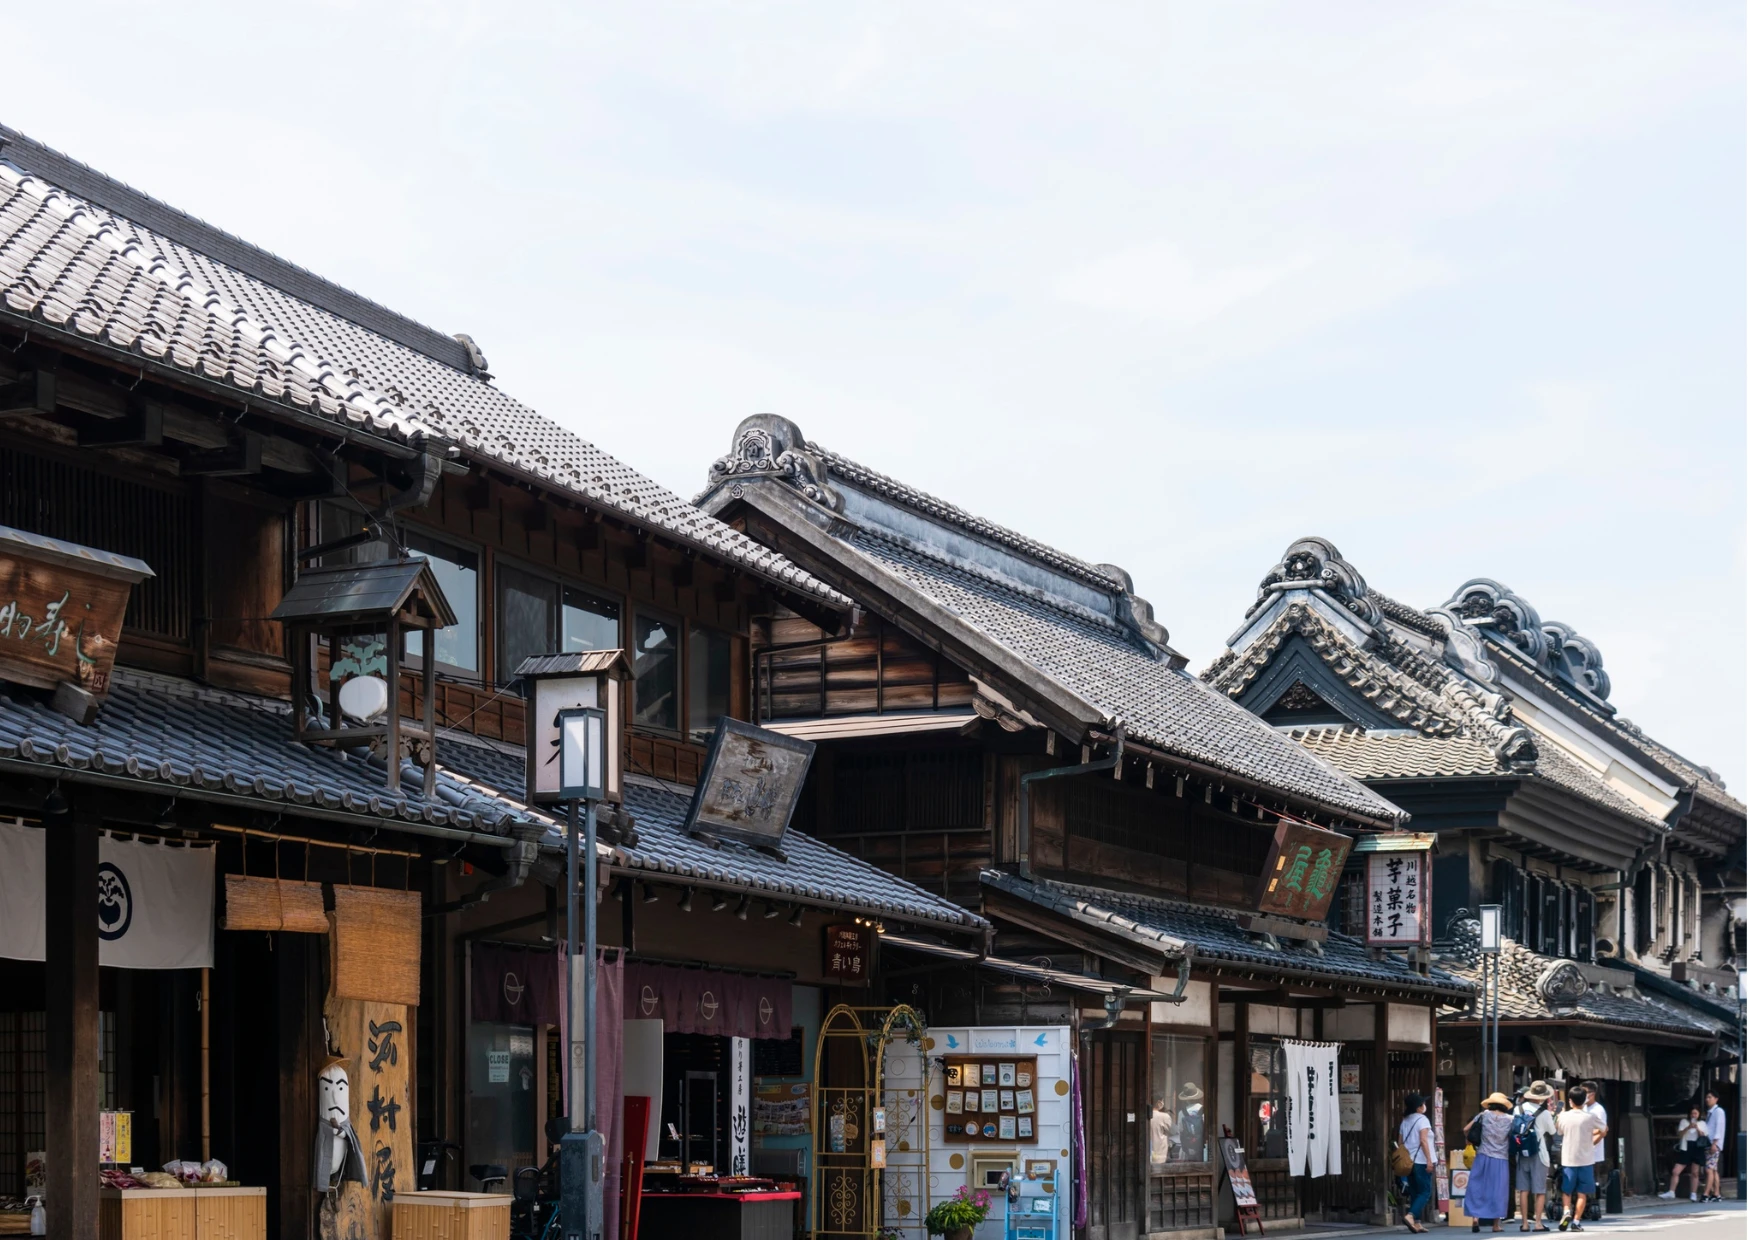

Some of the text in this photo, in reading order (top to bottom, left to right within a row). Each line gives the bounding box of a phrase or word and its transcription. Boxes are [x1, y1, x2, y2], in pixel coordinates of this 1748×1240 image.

[1386, 857, 1404, 937] 芋菓子
[1406, 860, 1417, 914] 川越名物
[832, 953, 861, 974] 青い鳥
[489, 1054, 509, 1065] CLOSE
[367, 1019, 402, 1205] 河村屋
